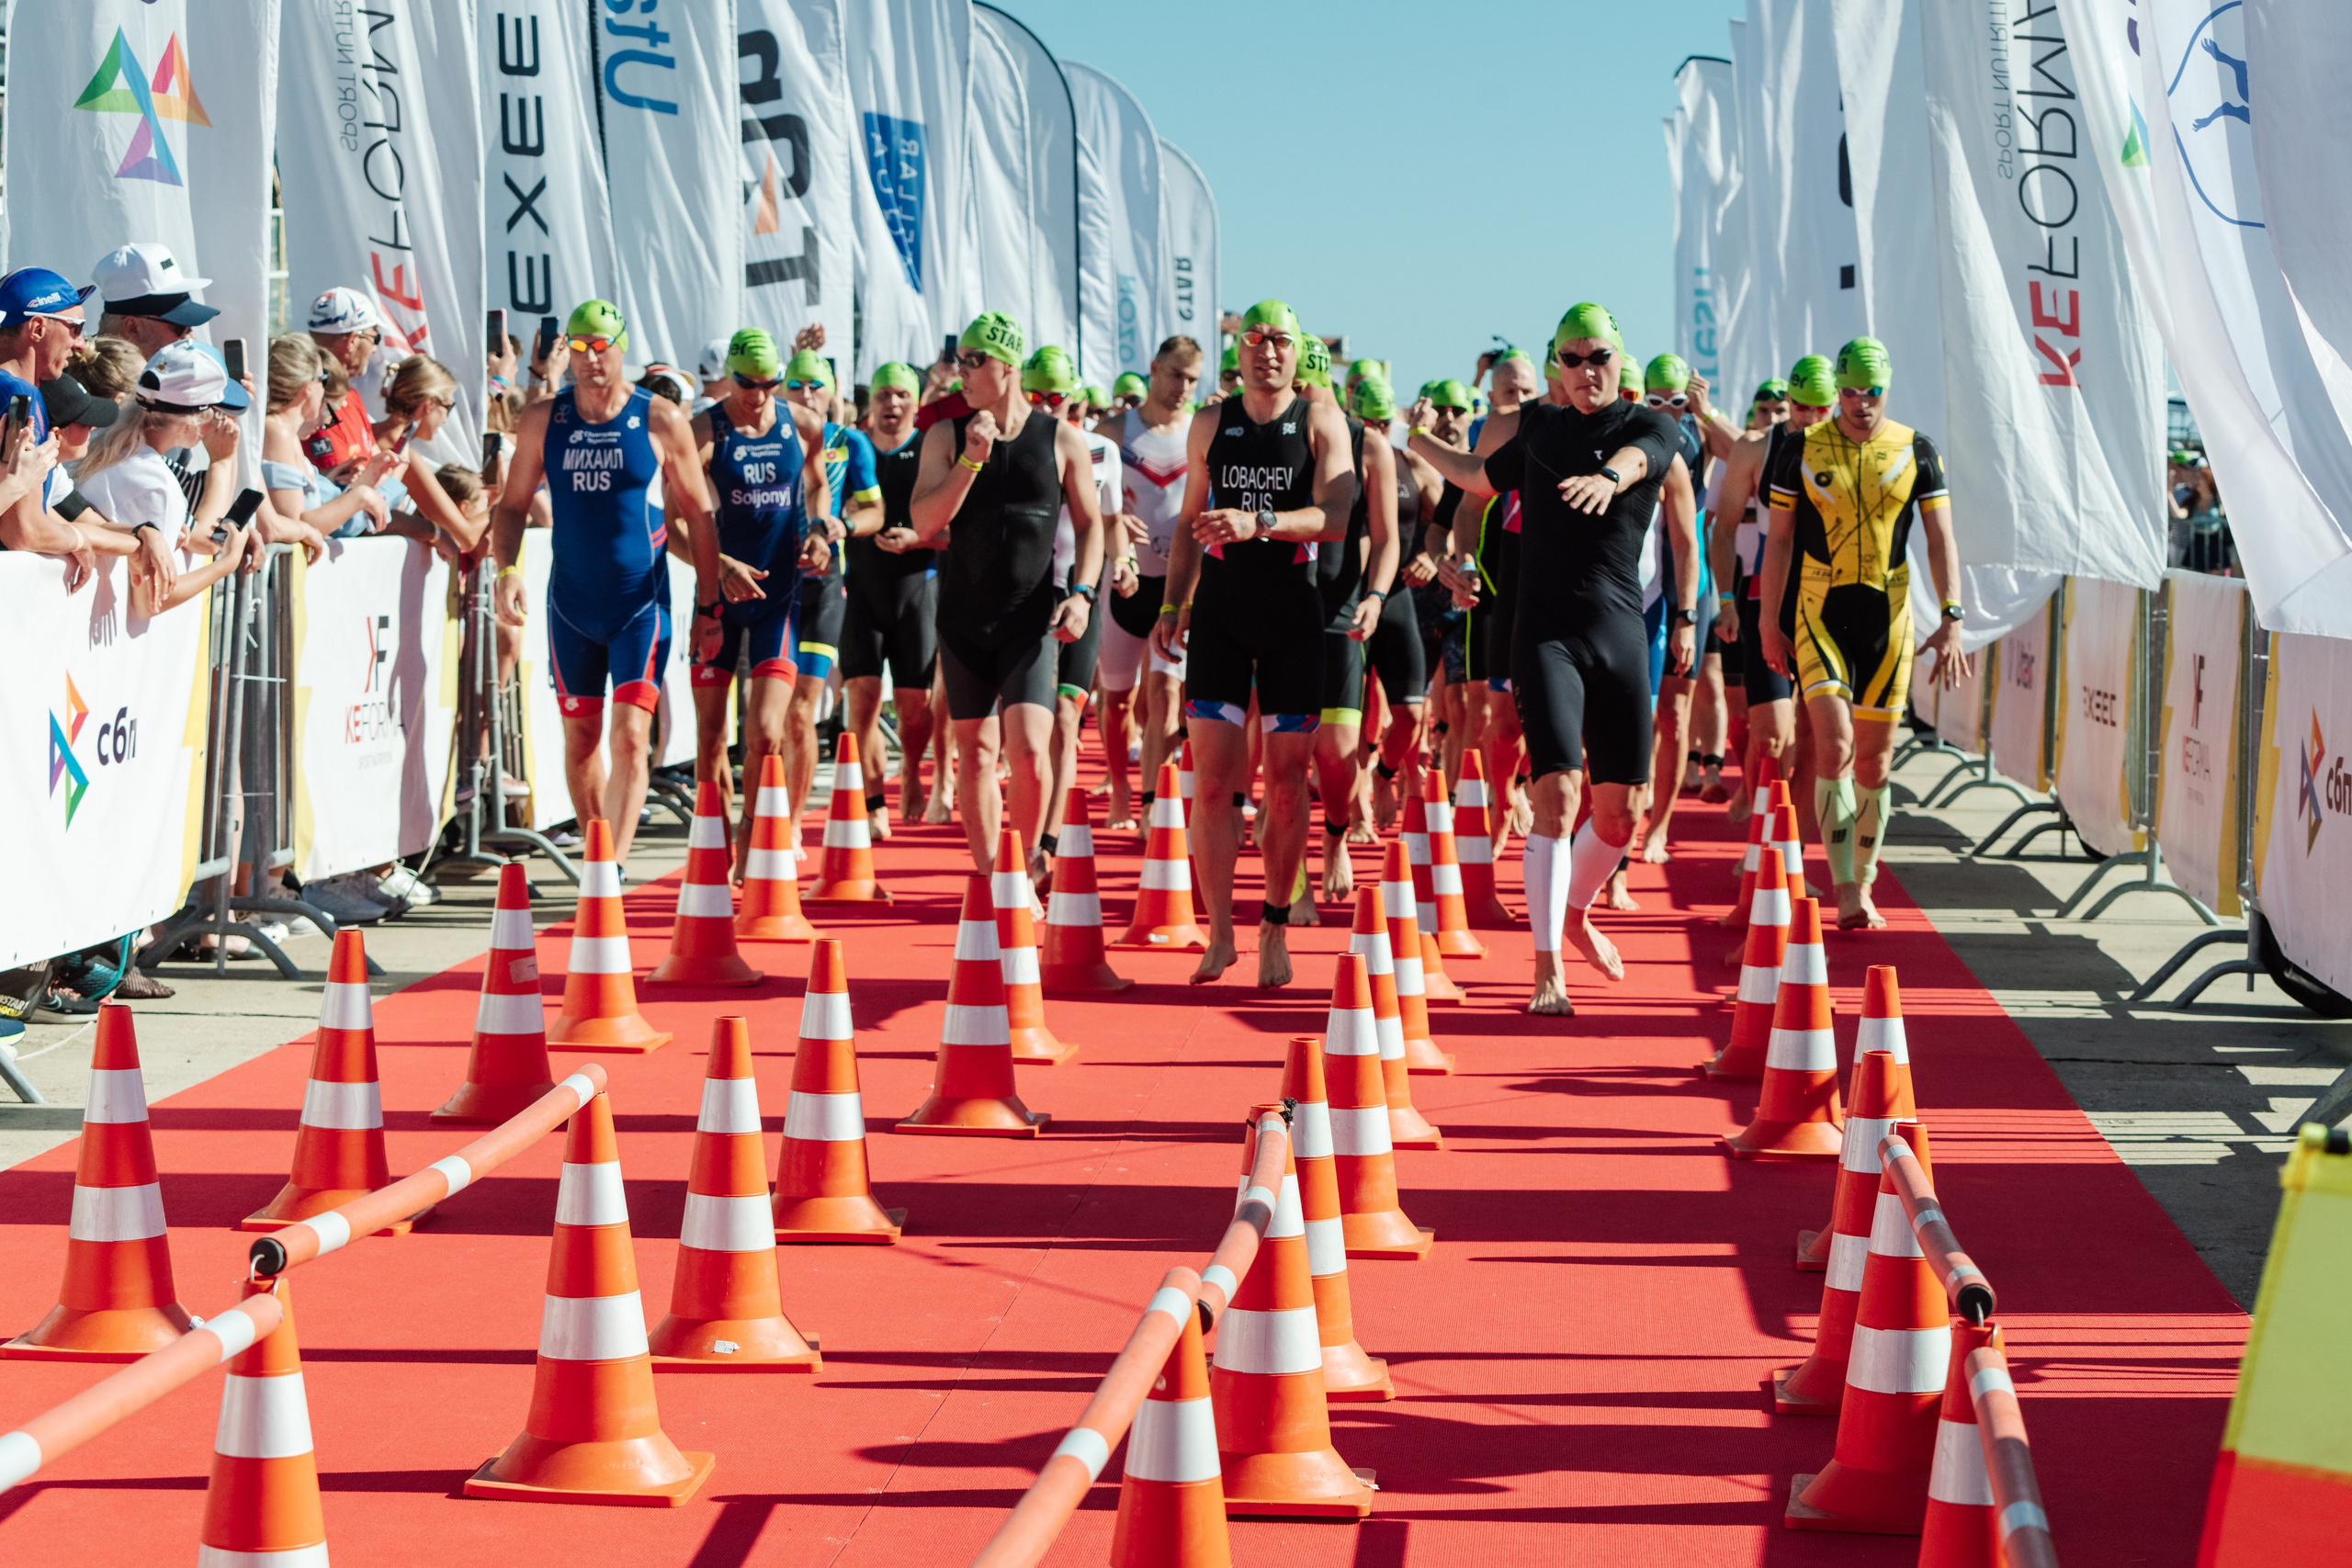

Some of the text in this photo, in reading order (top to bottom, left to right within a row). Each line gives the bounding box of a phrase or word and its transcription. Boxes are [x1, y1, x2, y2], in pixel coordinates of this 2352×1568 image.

[573, 471, 611, 491] RUS
[743, 462, 776, 484] RUS
[1222, 465, 1293, 490] LOBACHEV
[730, 487, 791, 508] Soljonyj
[1241, 491, 1273, 513] RUS
